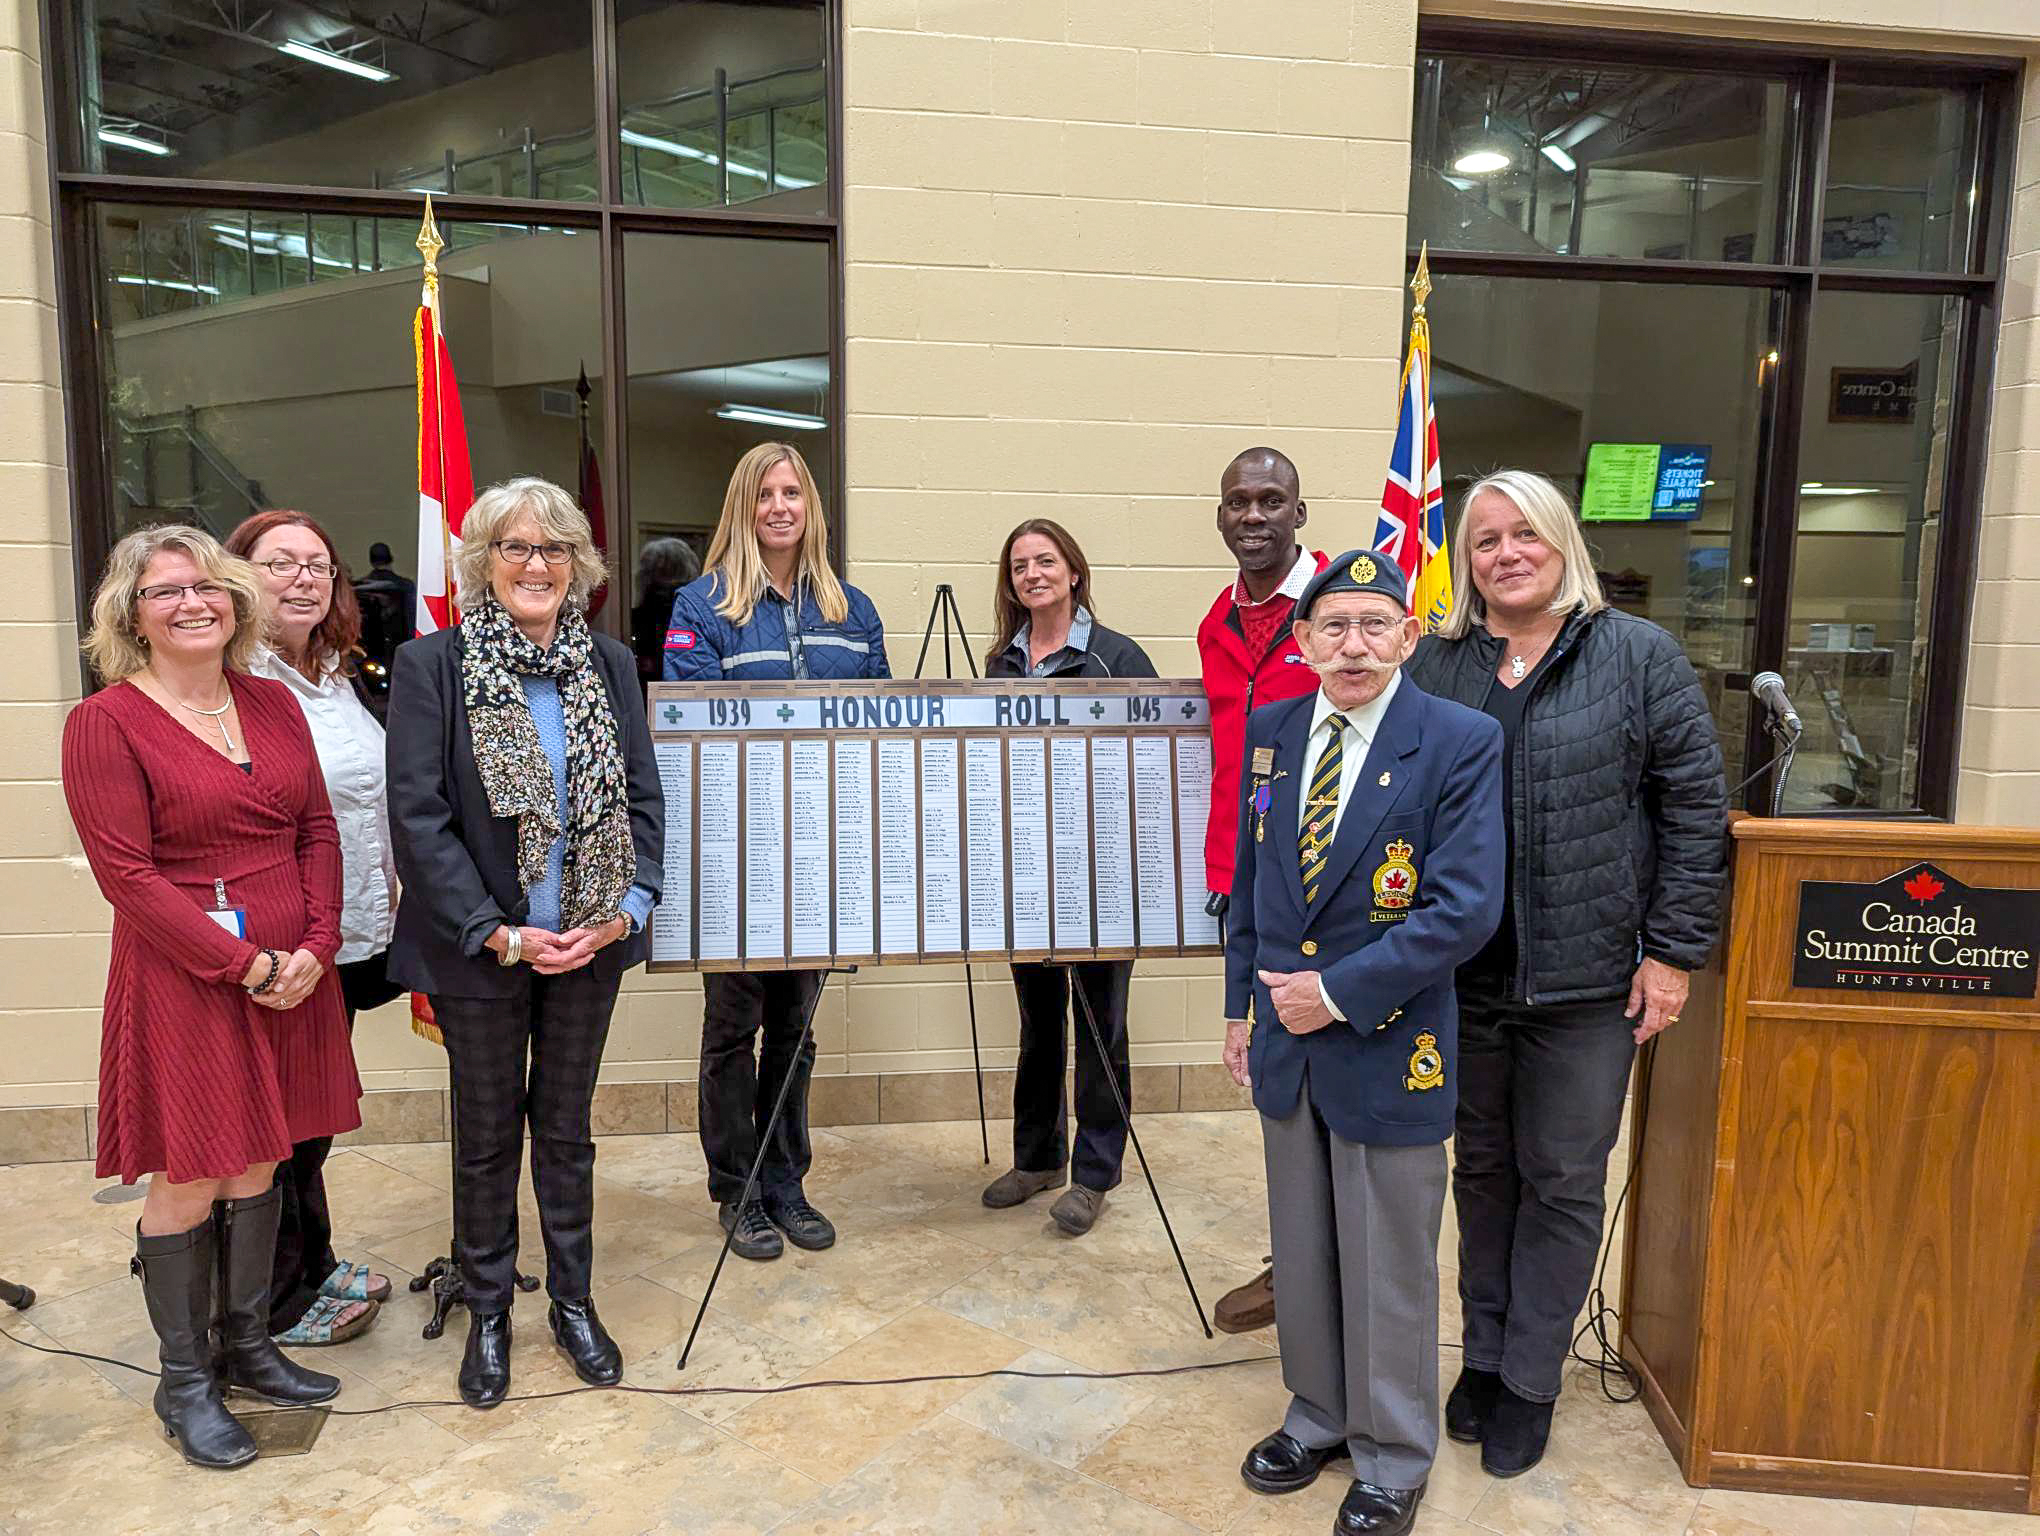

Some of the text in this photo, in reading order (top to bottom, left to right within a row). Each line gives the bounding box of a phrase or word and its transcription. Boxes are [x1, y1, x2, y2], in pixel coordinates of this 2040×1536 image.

[708, 694, 1161, 728] 1939 HONOUR ROLL 1945
[1861, 902, 1977, 937] Canada
[1804, 929, 2030, 969] Summit Centre
[1836, 973, 1992, 990] HUNTSVILLE
